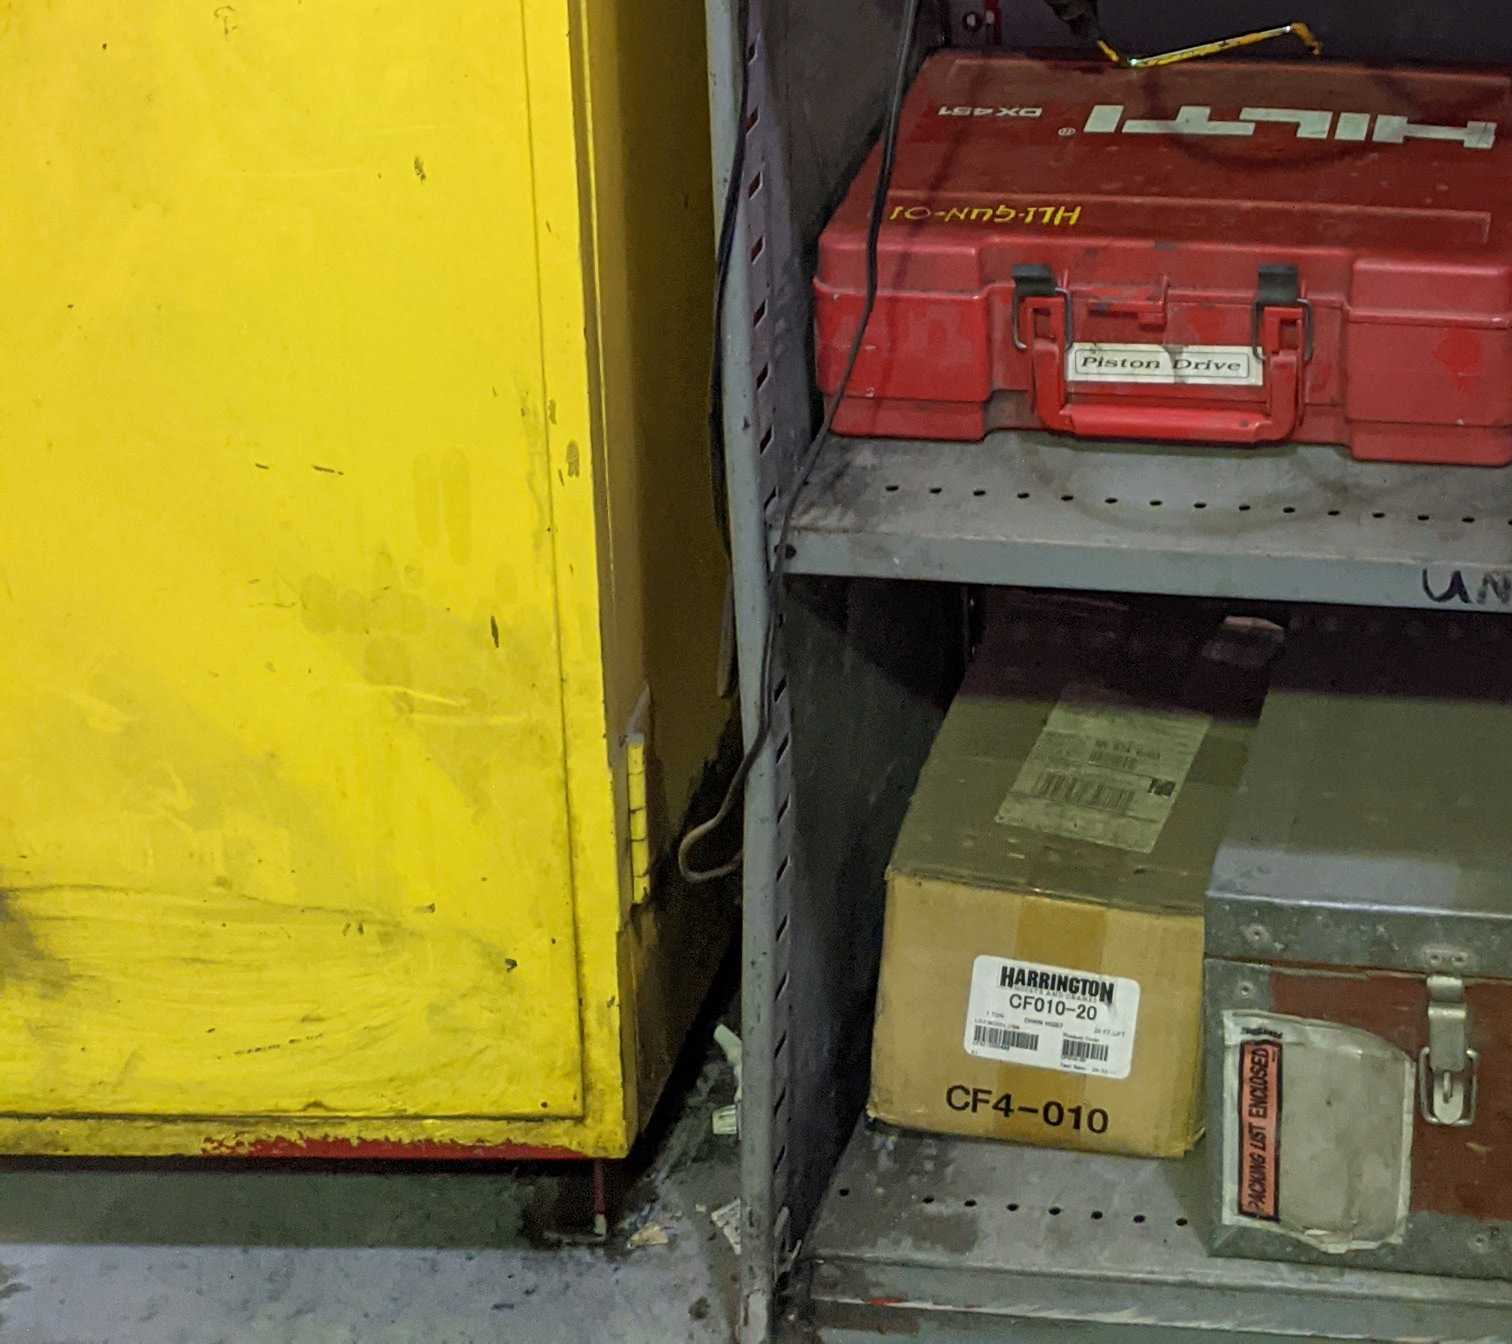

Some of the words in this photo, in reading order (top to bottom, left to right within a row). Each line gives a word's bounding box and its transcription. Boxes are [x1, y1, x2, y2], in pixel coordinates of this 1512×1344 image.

[998, 106, 1042, 117] DX
[1083, 104, 1498, 149] HILTI
[1081, 356, 1161, 370] Piston
[1173, 358, 1241, 371] Drive
[1000, 965, 1115, 1005] HARRINGTON
[1009, 994, 1097, 1021] CF010-20
[1248, 1047, 1269, 1119] ENCLOSED
[946, 1084, 1109, 1134] CF4-010
[1248, 1121, 1267, 1152] LIST
[1248, 1152, 1267, 1212] PACKING
